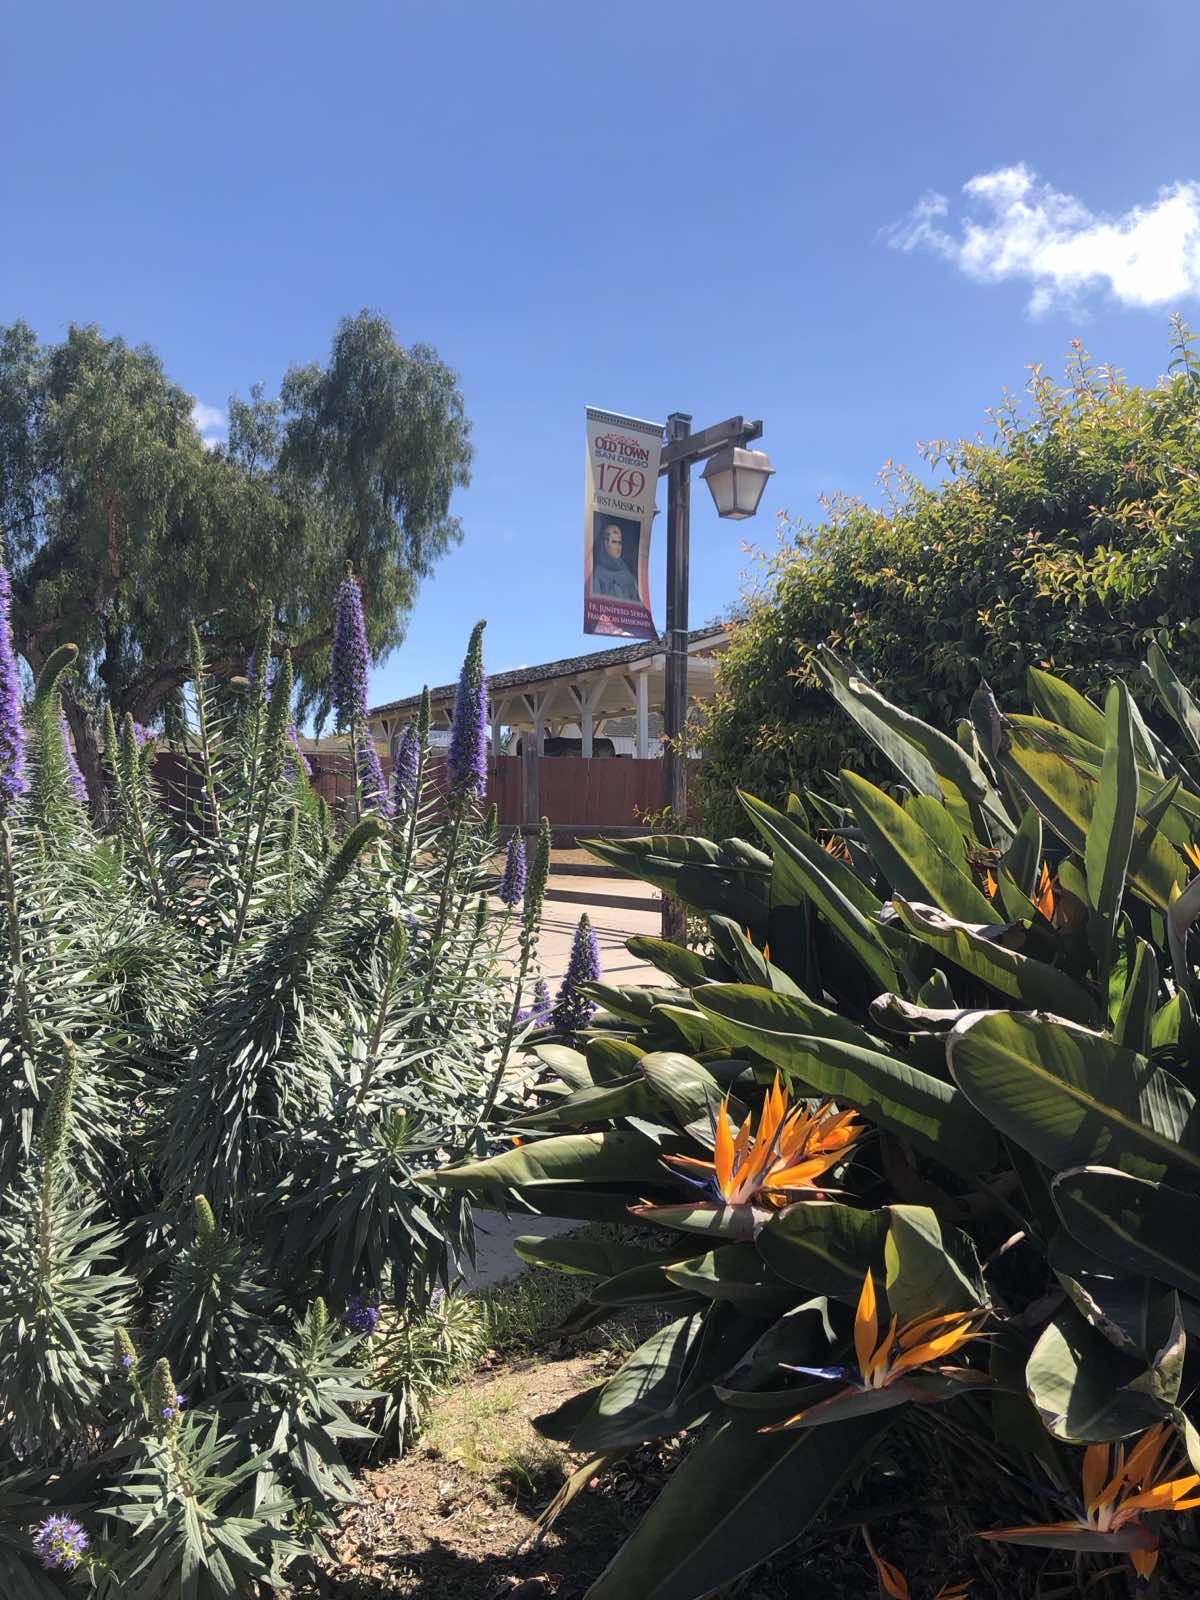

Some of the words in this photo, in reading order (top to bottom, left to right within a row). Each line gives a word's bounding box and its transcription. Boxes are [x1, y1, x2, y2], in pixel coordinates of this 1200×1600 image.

[595, 436, 617, 453] OLD
[620, 443, 650, 461] TOWN
[595, 450, 616, 461] SAN
[619, 455, 649, 468] DIEGO
[597, 463, 646, 498] 1769
[611, 498, 645, 513] MISSION
